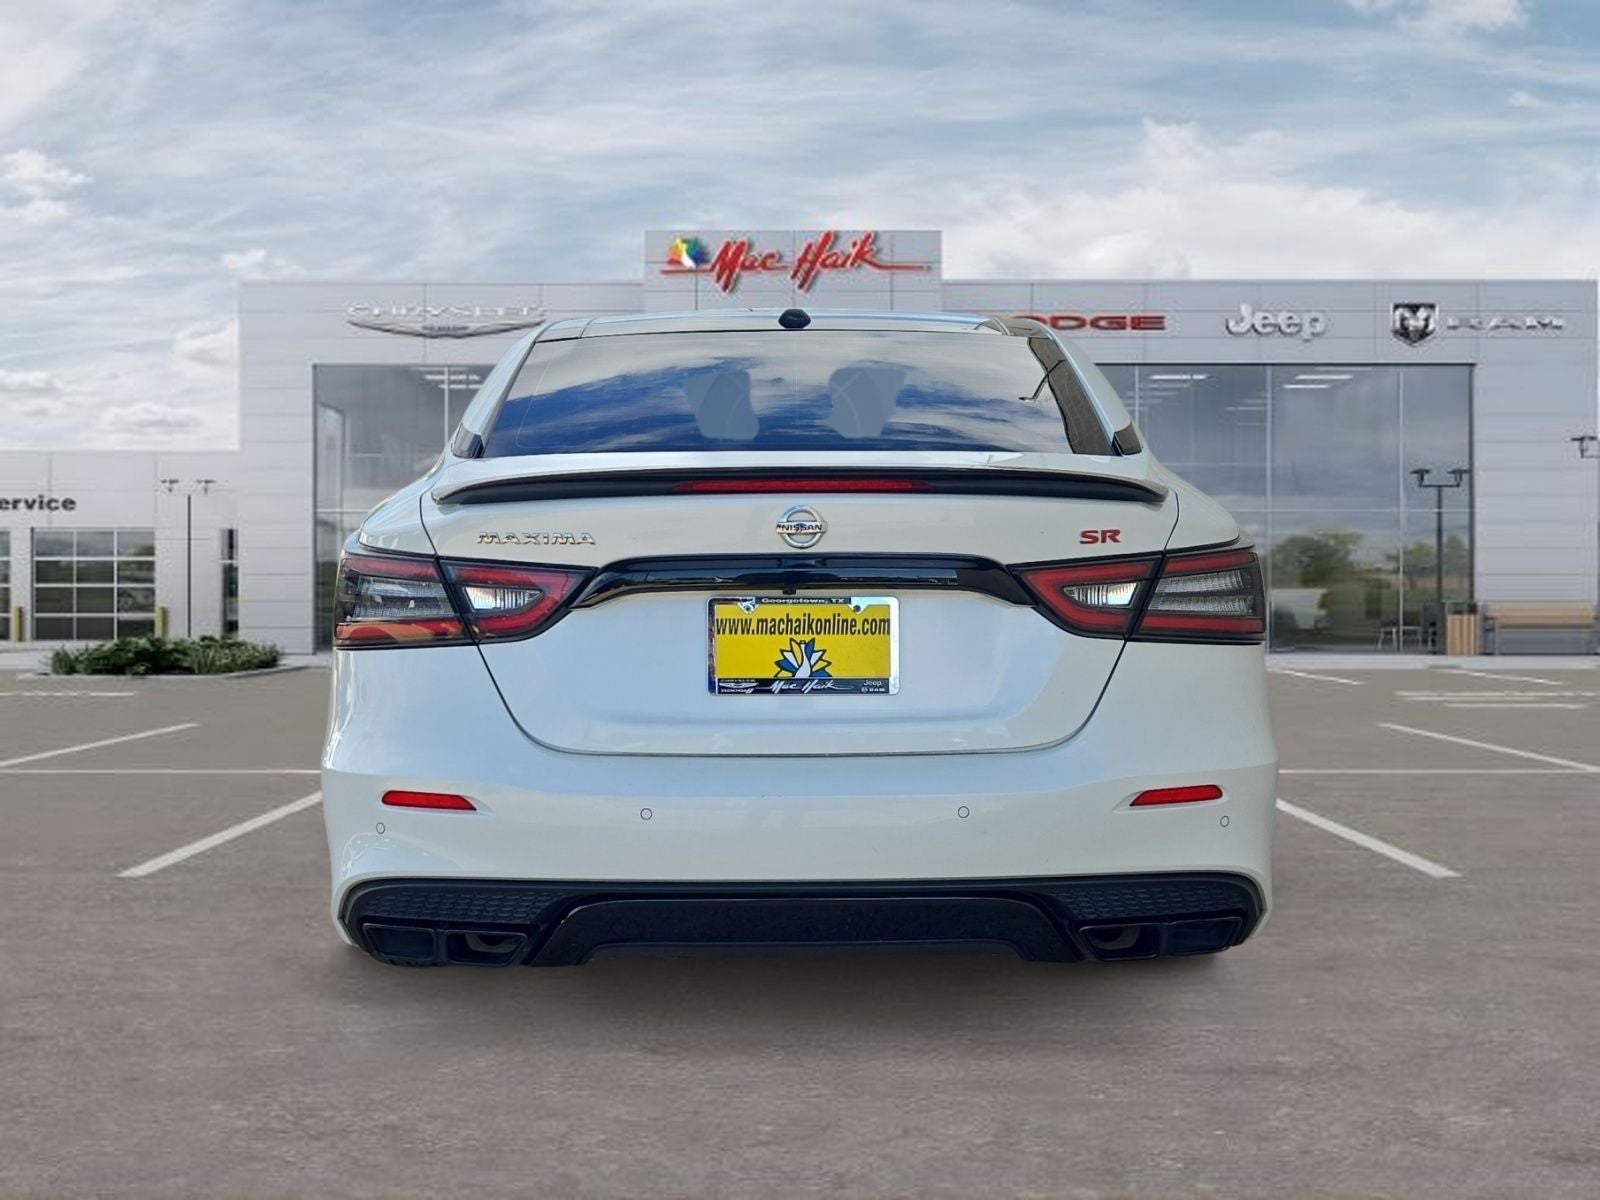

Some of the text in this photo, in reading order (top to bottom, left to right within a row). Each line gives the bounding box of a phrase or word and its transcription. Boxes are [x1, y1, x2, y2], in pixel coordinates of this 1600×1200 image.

[700, 230, 895, 293] Mac Haik
[1012, 315, 1166, 331] DGE
[1226, 303, 1326, 341] Jeep
[781, 523, 823, 532] NISSAN
[477, 532, 597, 546] MAXIMA
[1079, 528, 1121, 544] SR
[716, 613, 890, 635] www.machaikonline.com
[768, 680, 797, 693] Mac
[801, 679, 842, 693] Haik
[863, 679, 882, 687] Jeep
